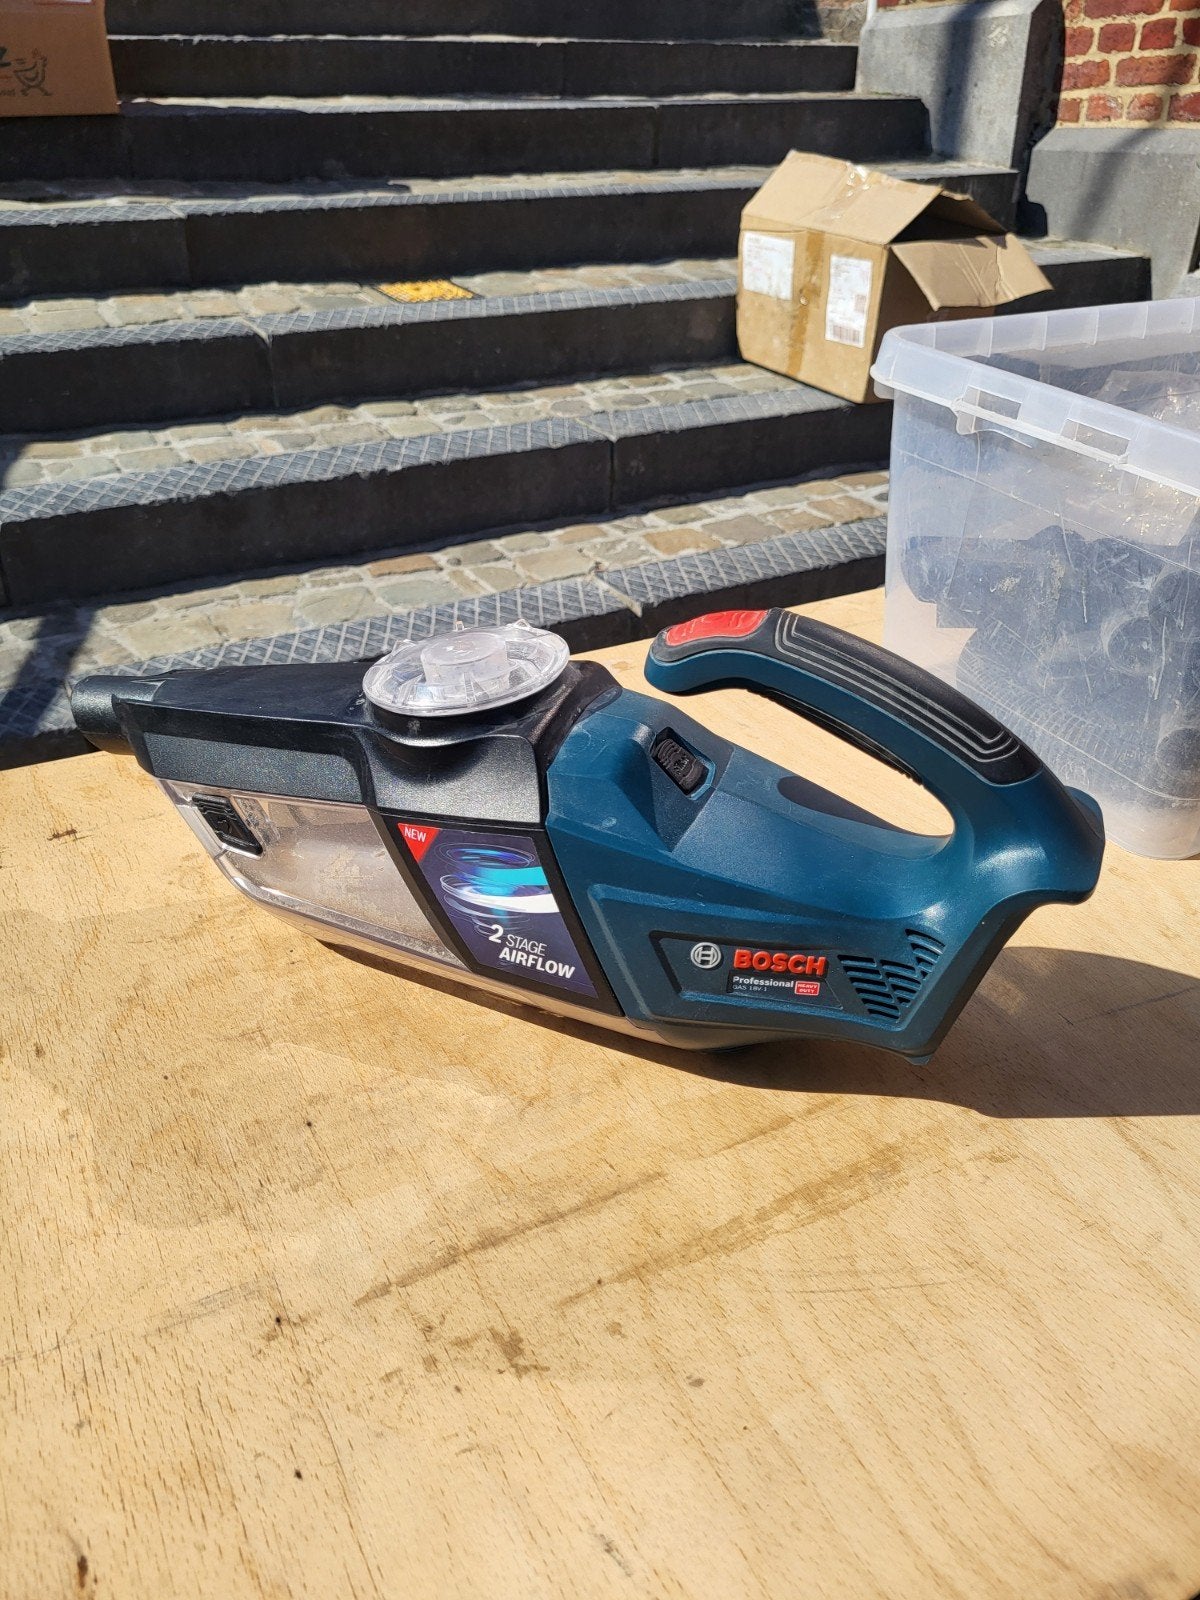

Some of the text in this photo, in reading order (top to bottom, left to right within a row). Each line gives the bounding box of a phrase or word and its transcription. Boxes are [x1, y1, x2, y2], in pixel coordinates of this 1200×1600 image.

[404, 826, 427, 843] NEW
[488, 924, 547, 956] 2 STAGE
[499, 947, 576, 979] AIRFLOW
[733, 949, 827, 976] BOSCH
[733, 976, 794, 988] Professional
